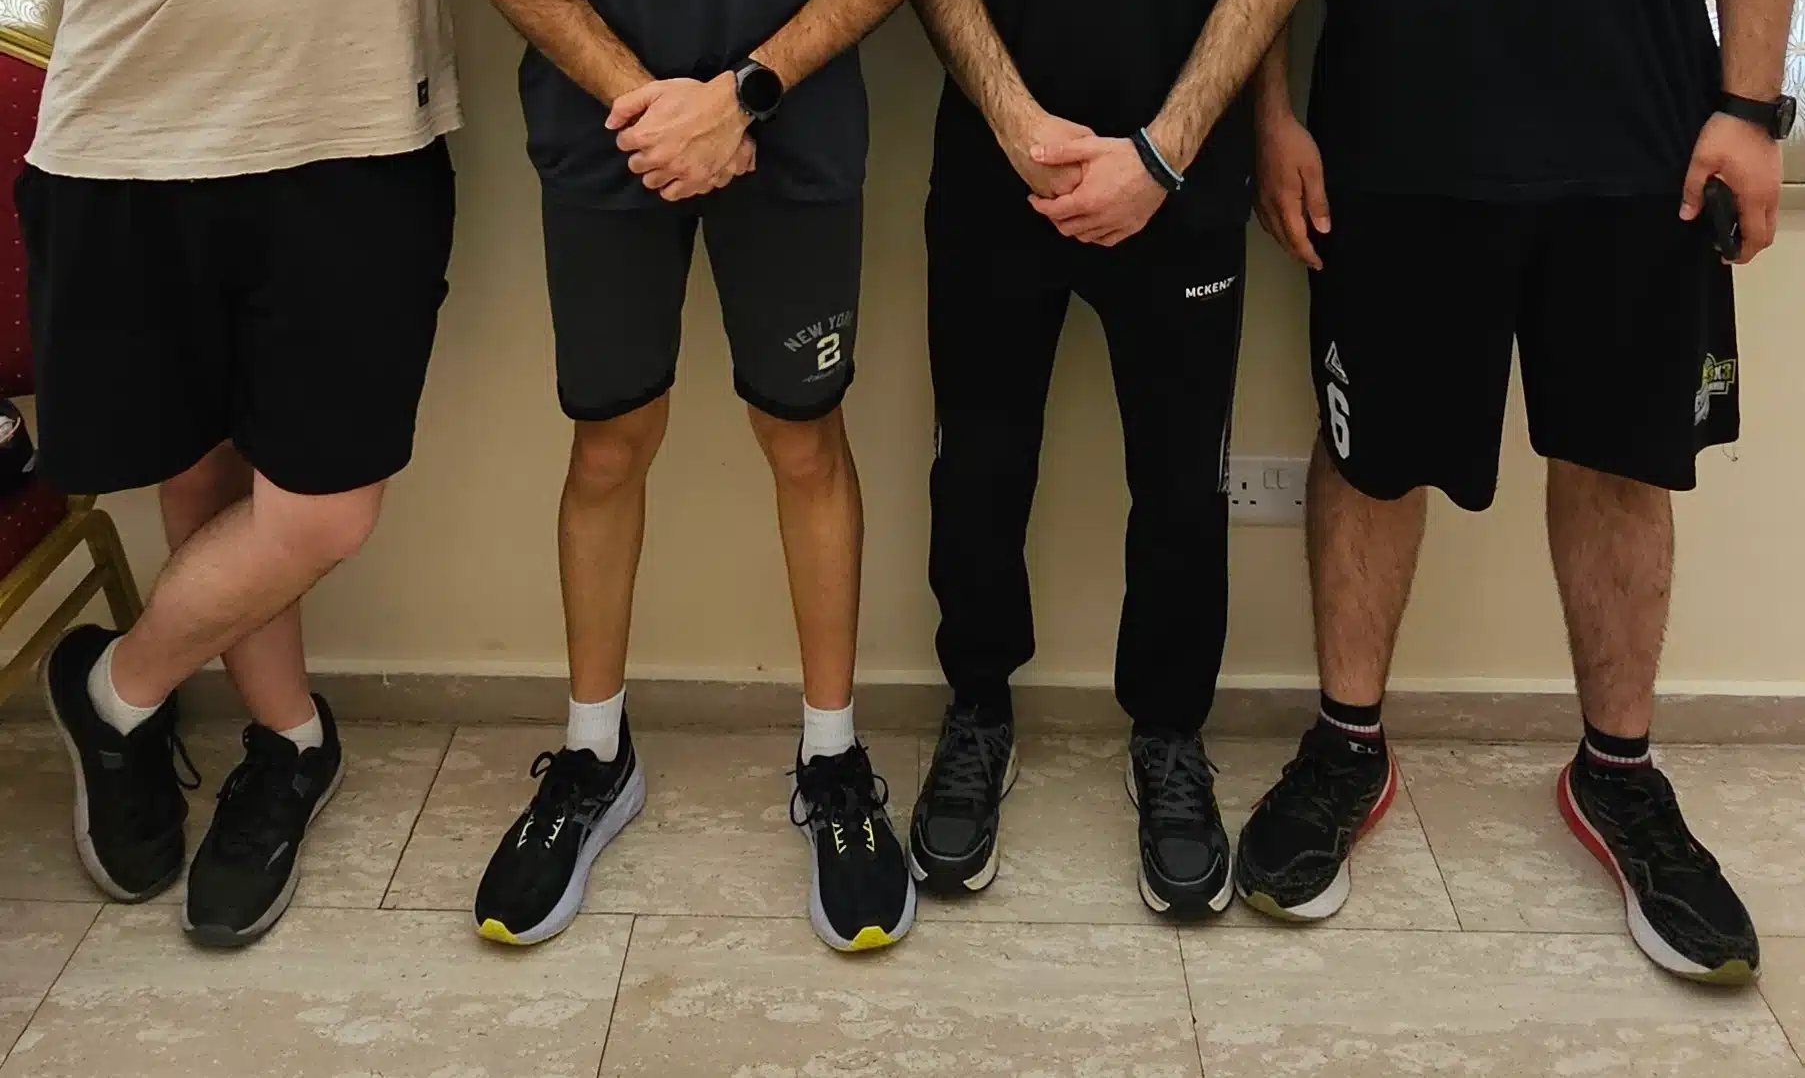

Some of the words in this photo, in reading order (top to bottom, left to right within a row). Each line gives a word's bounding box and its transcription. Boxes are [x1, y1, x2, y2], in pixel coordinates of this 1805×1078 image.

[1185, 275, 1239, 298] MCKENZ
[784, 322, 823, 352] NEW
[817, 333, 841, 370] 2
[1326, 382, 1350, 459] 6
